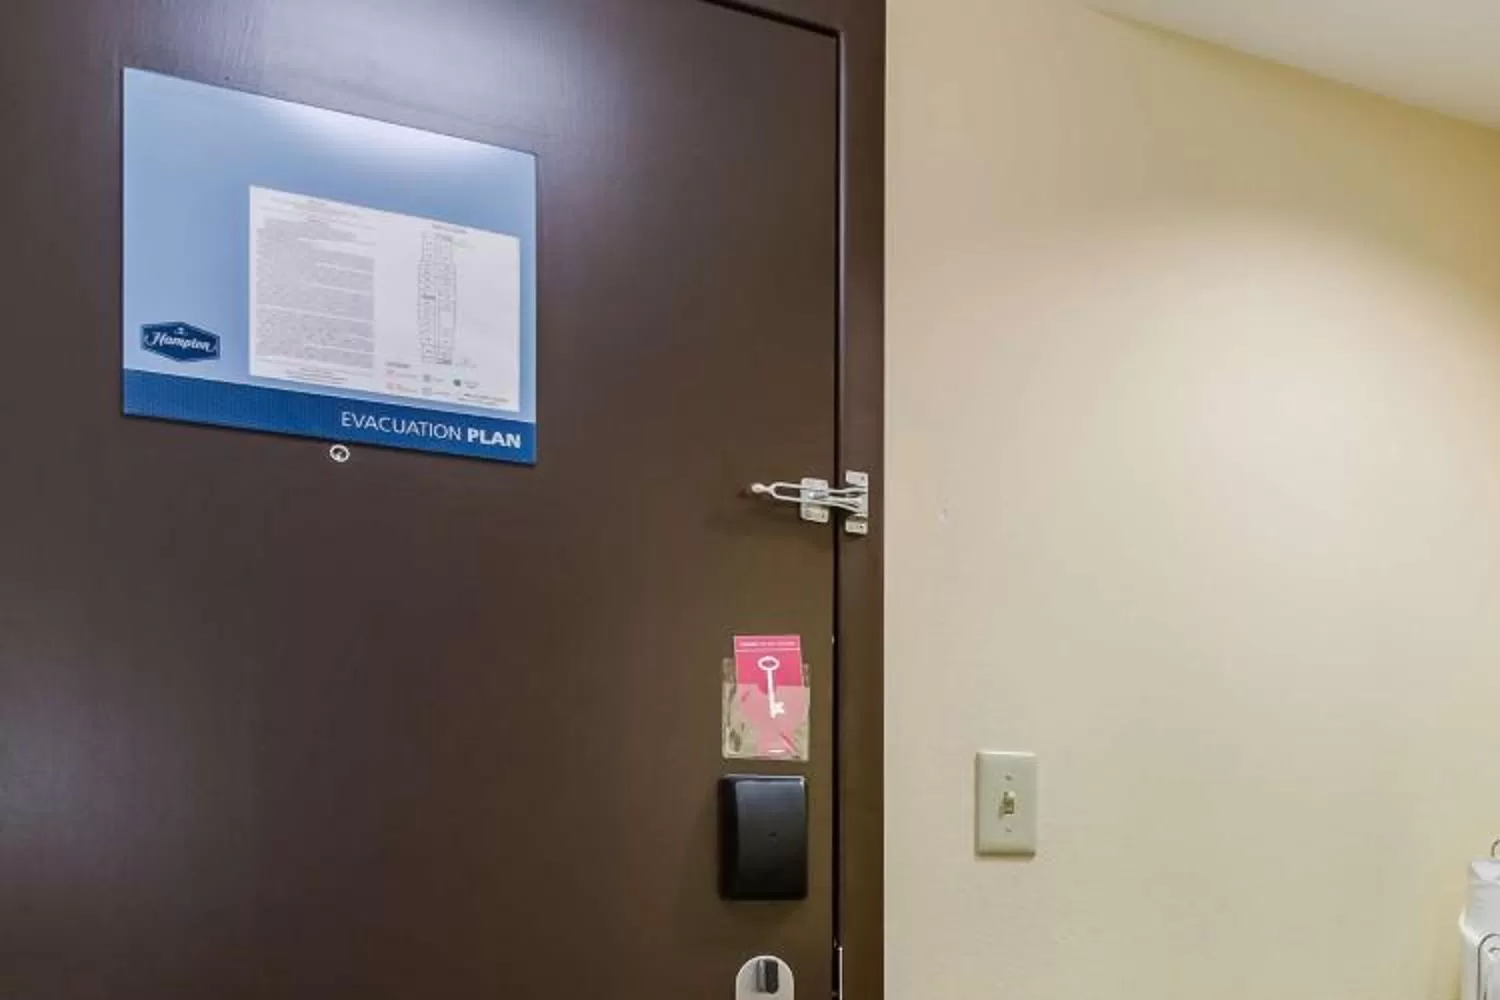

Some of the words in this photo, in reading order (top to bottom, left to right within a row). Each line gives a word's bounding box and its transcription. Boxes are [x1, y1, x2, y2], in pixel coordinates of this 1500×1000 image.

[144, 331, 216, 352] Hampton
[340, 411, 463, 441] EVACUATION
[467, 427, 522, 449] PLAN
